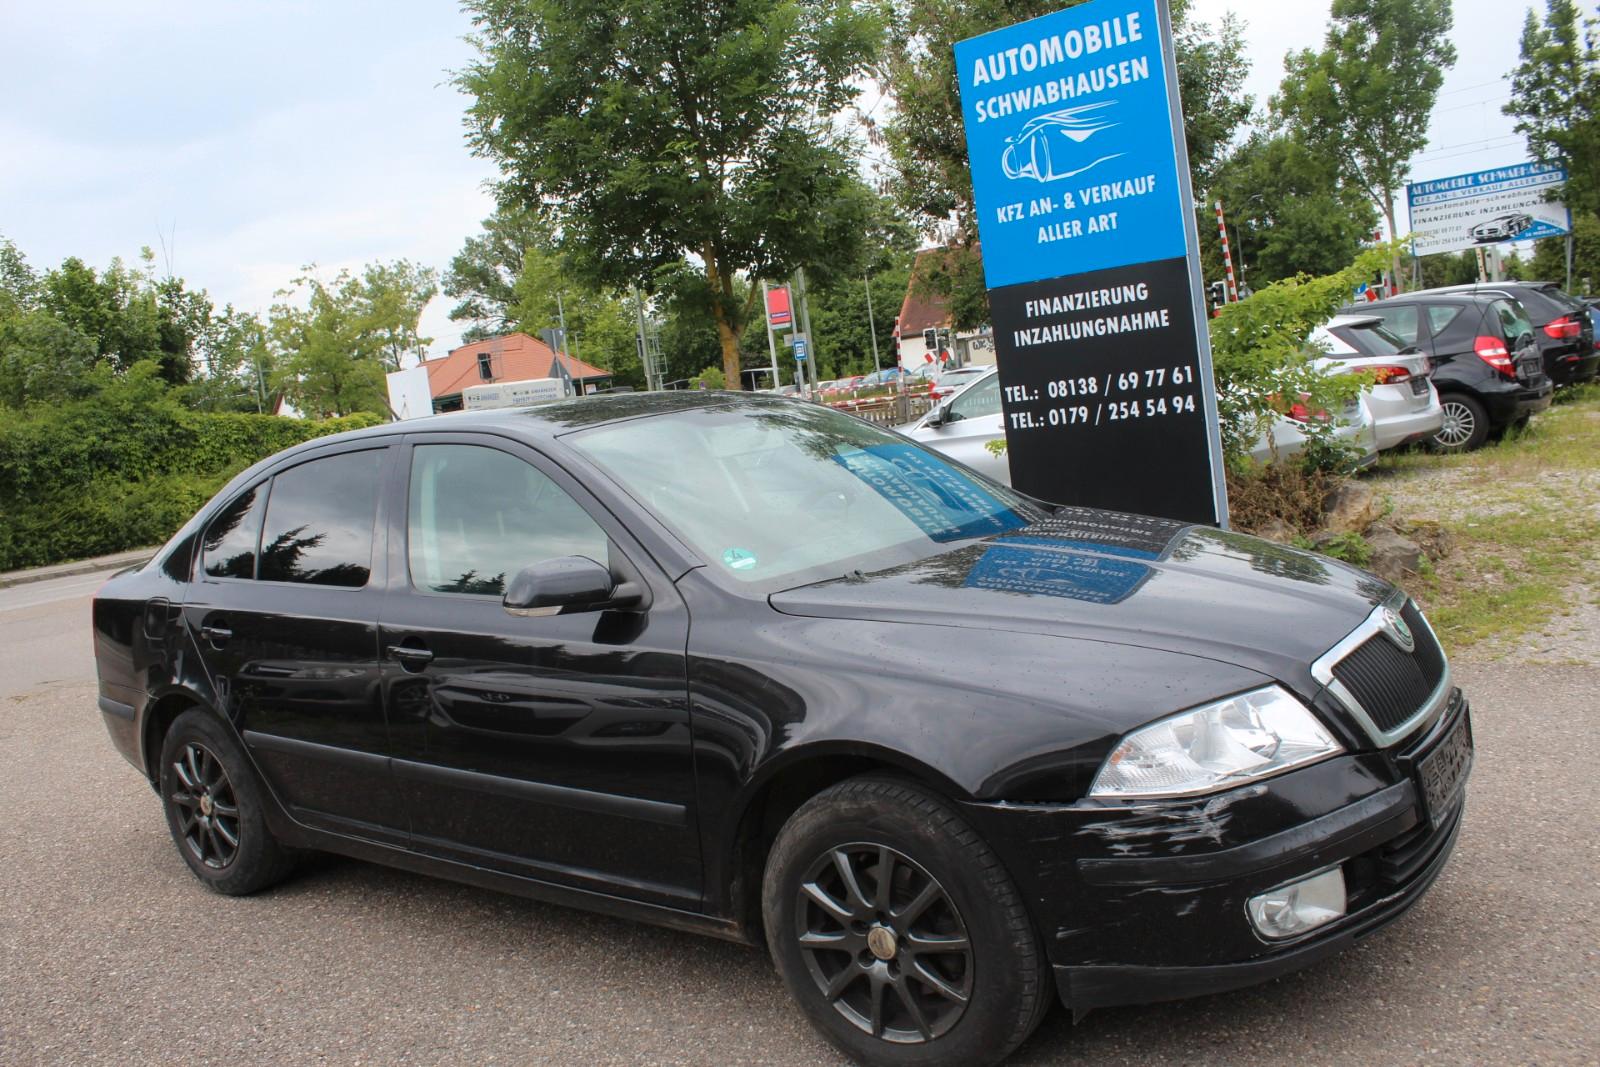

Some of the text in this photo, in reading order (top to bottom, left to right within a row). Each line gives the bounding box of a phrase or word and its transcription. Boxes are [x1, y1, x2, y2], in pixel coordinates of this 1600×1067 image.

[973, 11, 1143, 87] AUTOMOBILE
[975, 56, 1149, 123] SCHWABHAUSEN
[997, 174, 1155, 223] KFZ AN- & VERKAUF
[1412, 175, 1474, 195] AUTOMOBILE
[1037, 212, 1118, 244] ALLER ART
[1413, 199, 1546, 226] FINANZIERUNG INZAHLUNGNA
[1026, 283, 1149, 318] FINANZIERUNG
[1014, 309, 1170, 347] INZAHLUNGNAHME
[1005, 365, 1193, 403] TEL.: 08138 / 69 77 61
[1011, 395, 1195, 429] TEL.: 0179 / 254 54 94
